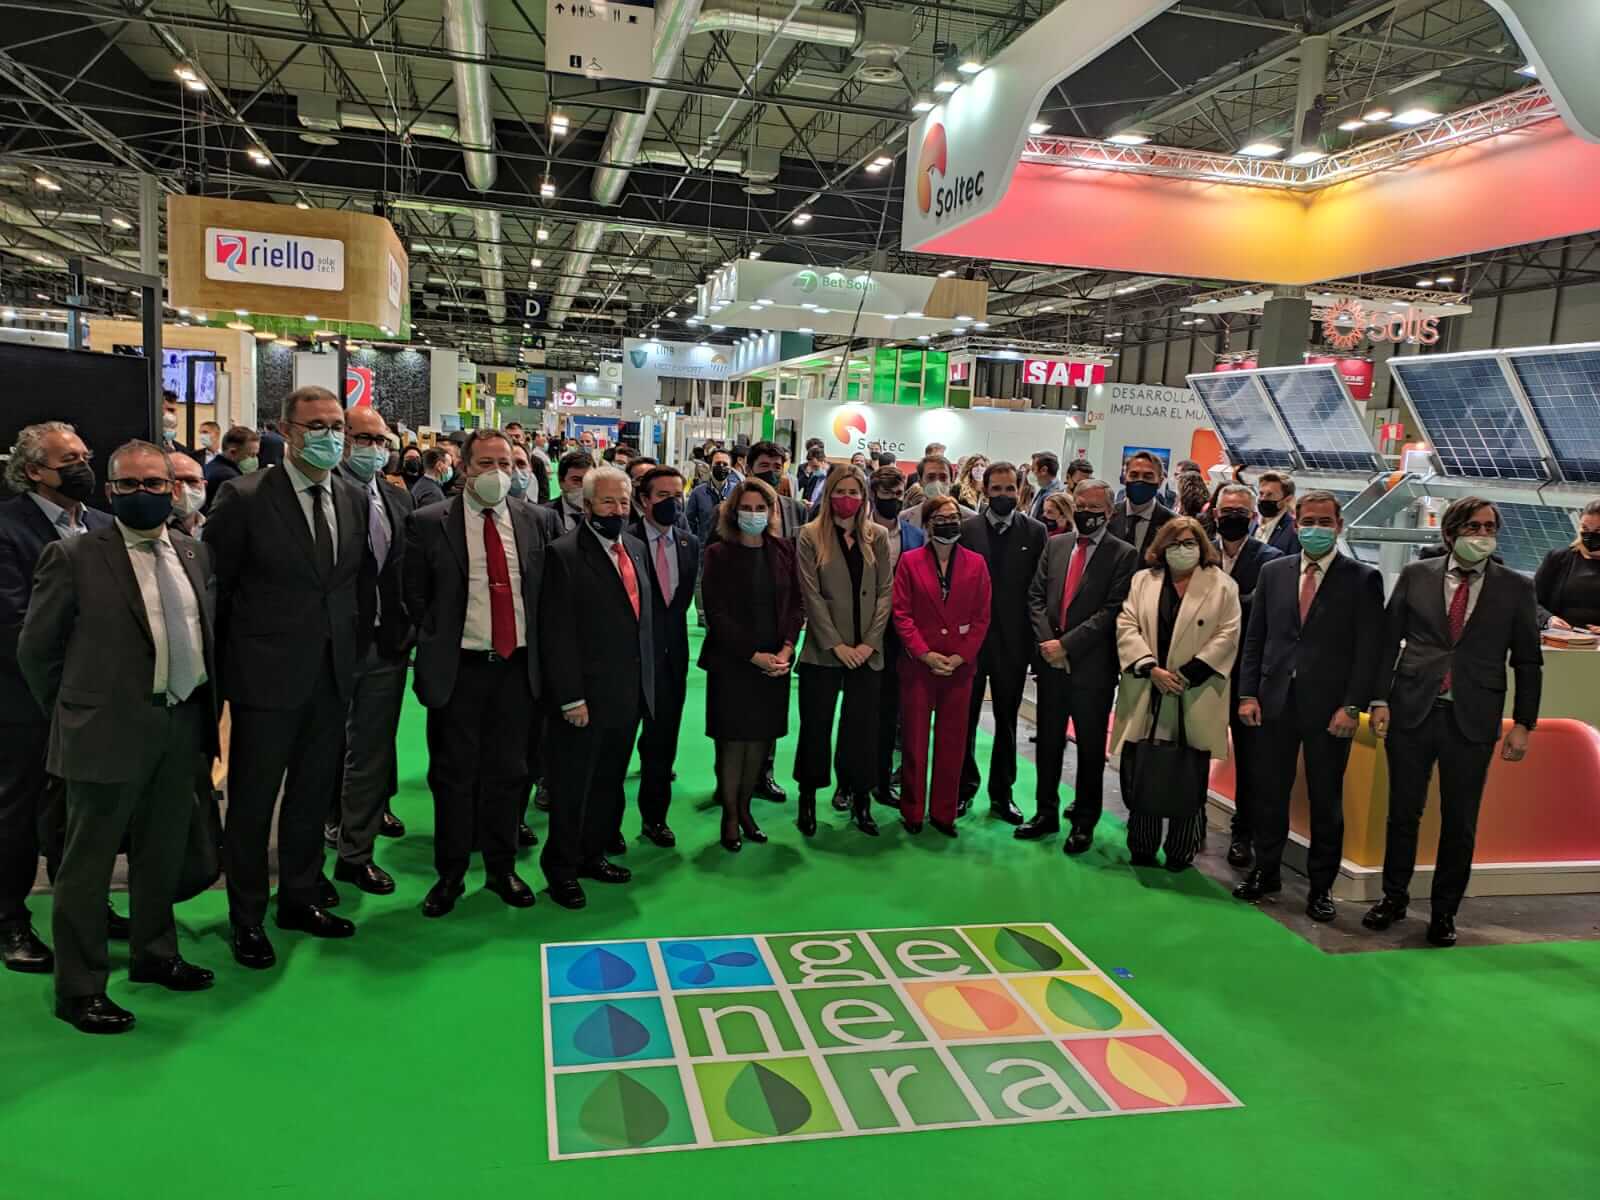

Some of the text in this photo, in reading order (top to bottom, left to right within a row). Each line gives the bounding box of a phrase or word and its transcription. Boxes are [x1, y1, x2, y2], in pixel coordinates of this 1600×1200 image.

[935, 170, 985, 217] Soltec
[251, 238, 314, 271] riello
[822, 276, 845, 288] Bet
[526, 299, 541, 317] D
[1028, 360, 1093, 387] SAJ
[1110, 403, 1168, 418] IMPULSAR
[1170, 407, 1182, 419] EL
[857, 438, 906, 453] Stec
